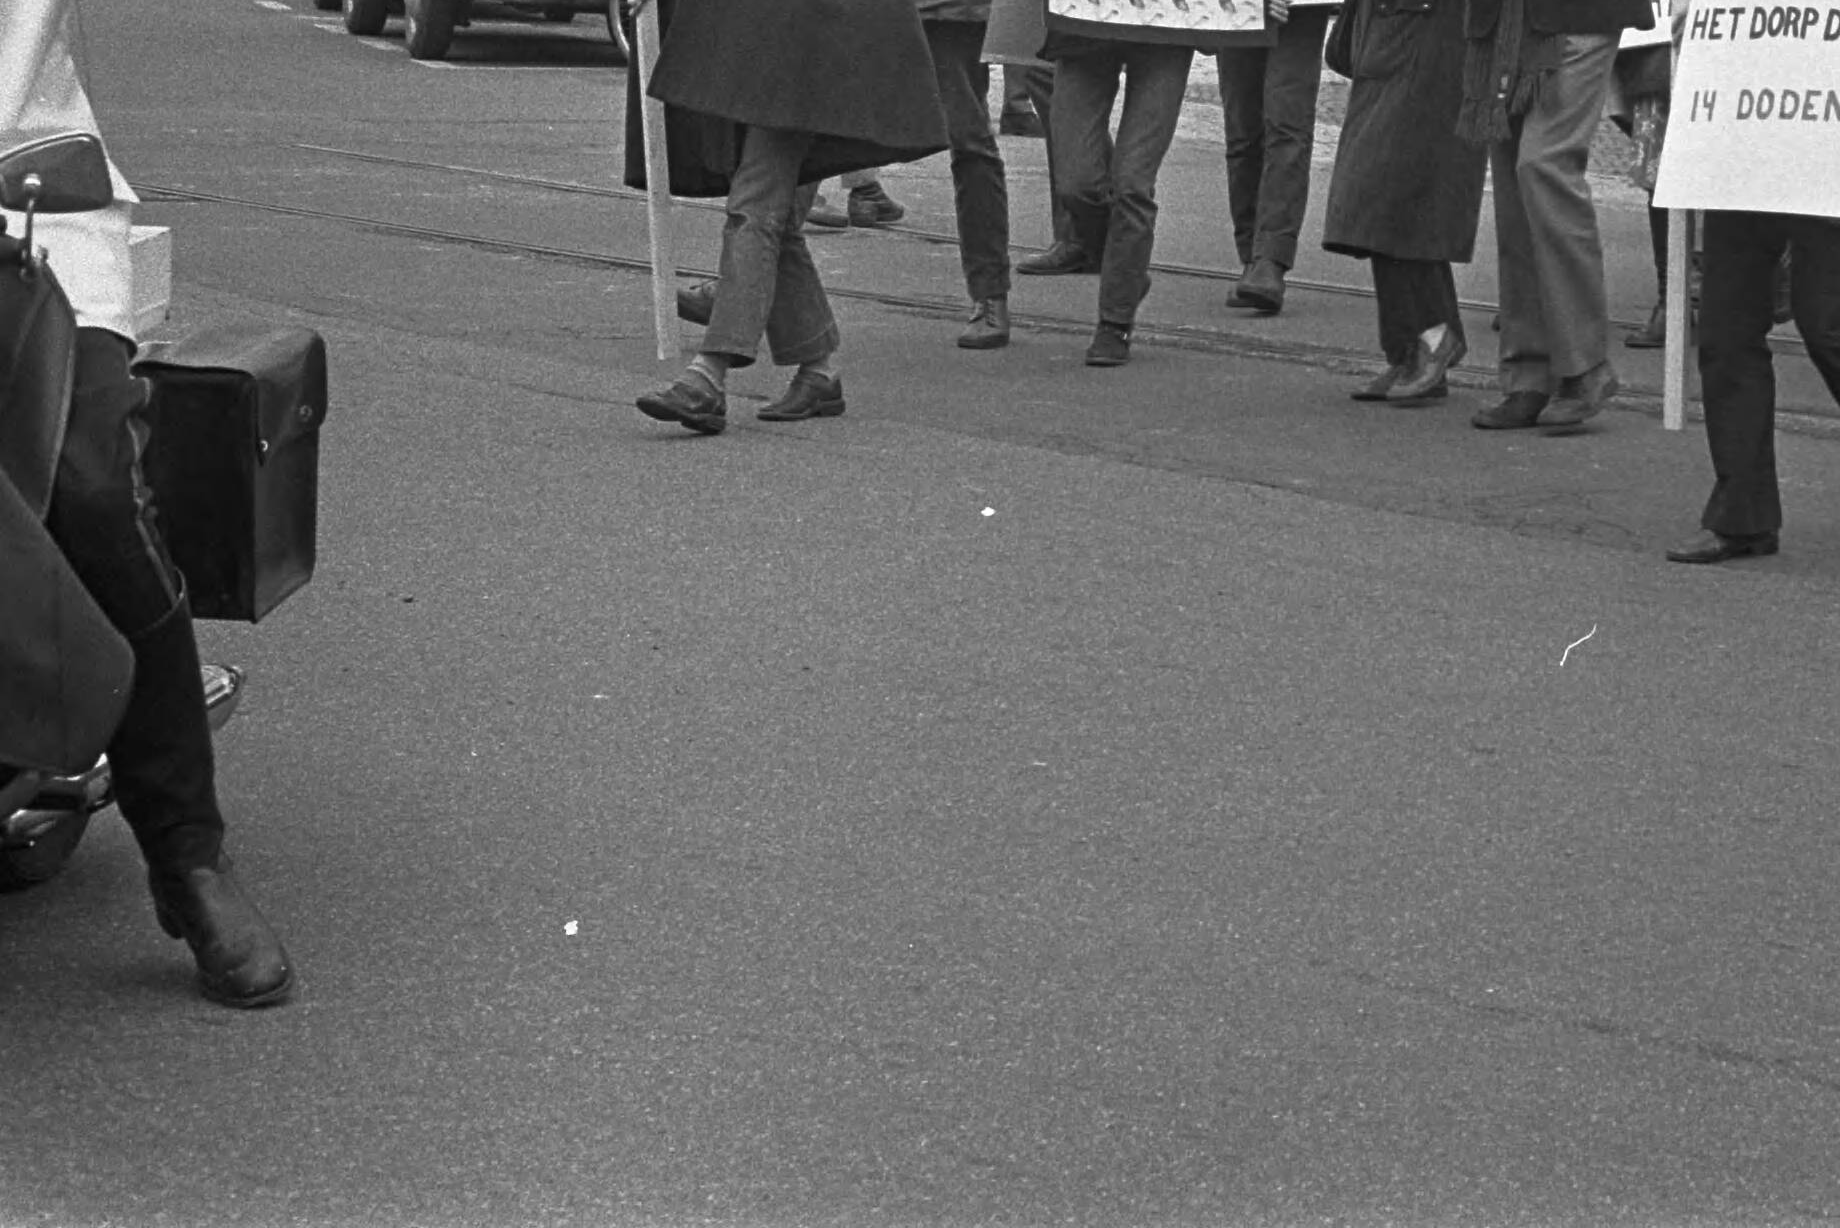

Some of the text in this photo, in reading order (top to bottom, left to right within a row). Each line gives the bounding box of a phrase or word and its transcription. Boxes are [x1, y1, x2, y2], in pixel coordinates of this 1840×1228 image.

[1691, 7, 1745, 40] HET
[1749, 7, 1819, 40] DORP
[1691, 90, 1717, 123] 14
